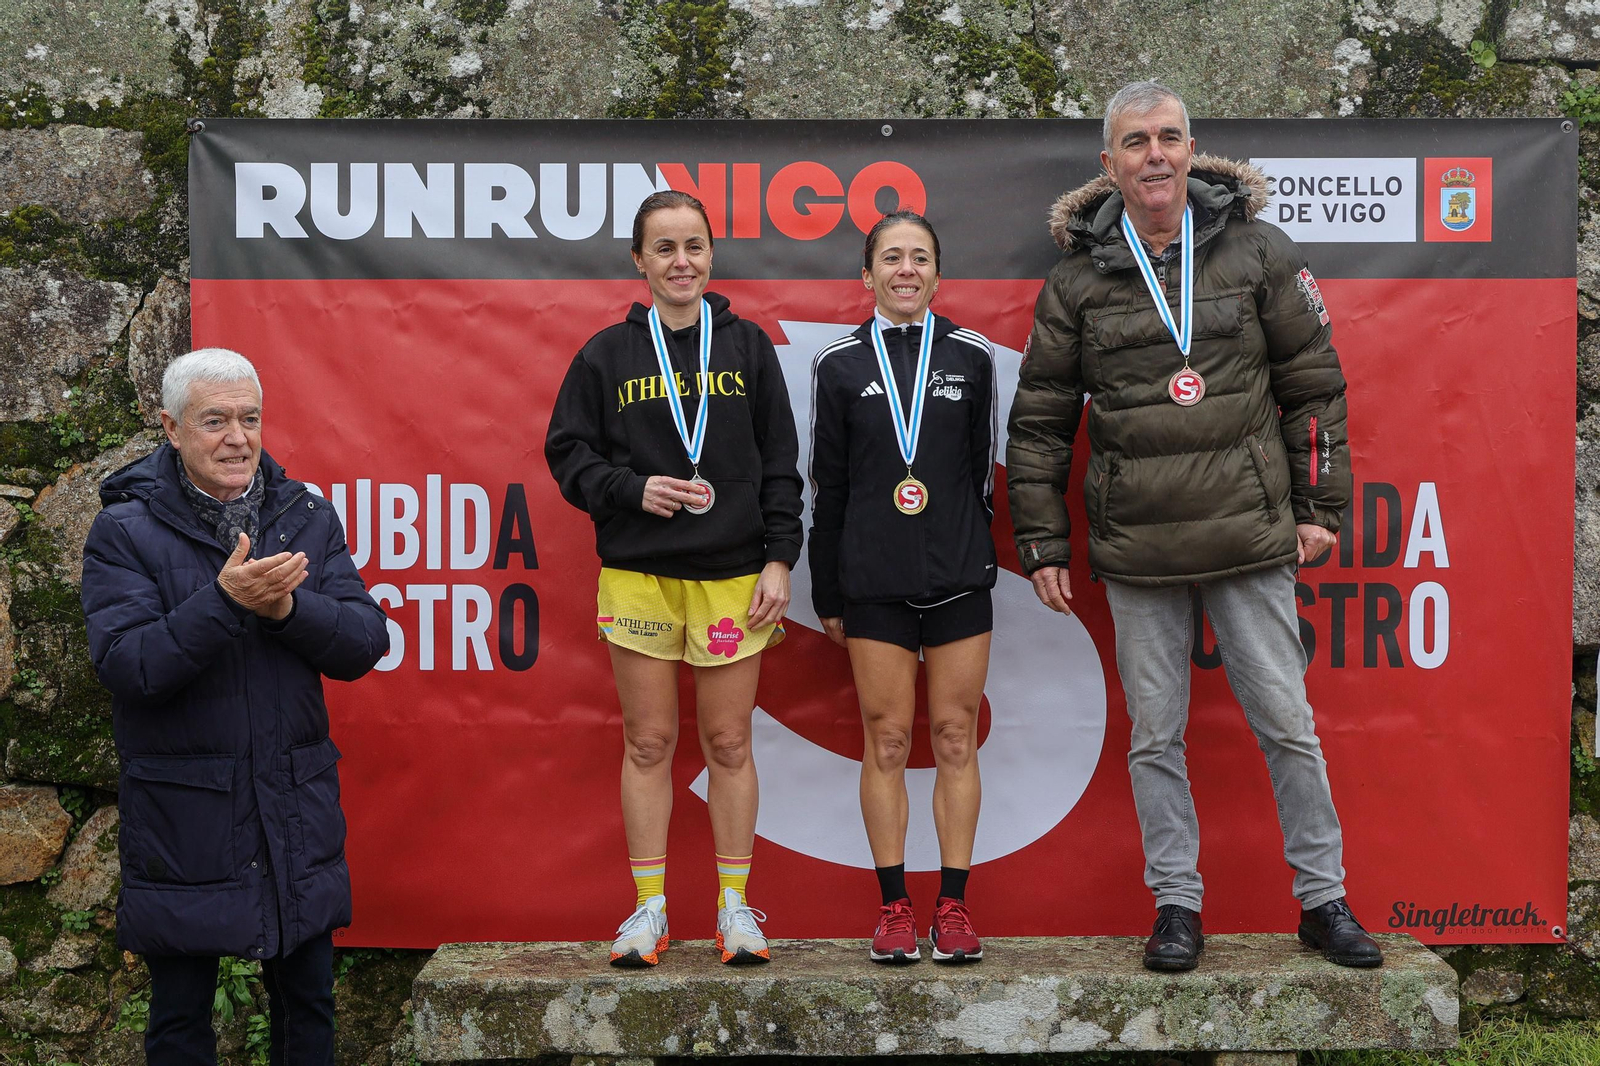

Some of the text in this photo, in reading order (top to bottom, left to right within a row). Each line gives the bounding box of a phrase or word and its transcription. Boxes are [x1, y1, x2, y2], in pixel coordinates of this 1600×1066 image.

[1279, 203, 1386, 223] DE VIGO
[305, 474, 539, 570] UBIDA
[368, 583, 540, 672] STRO
[615, 617, 673, 632] ATHLETICS
[1448, 927, 1547, 935] Outdoor sports
